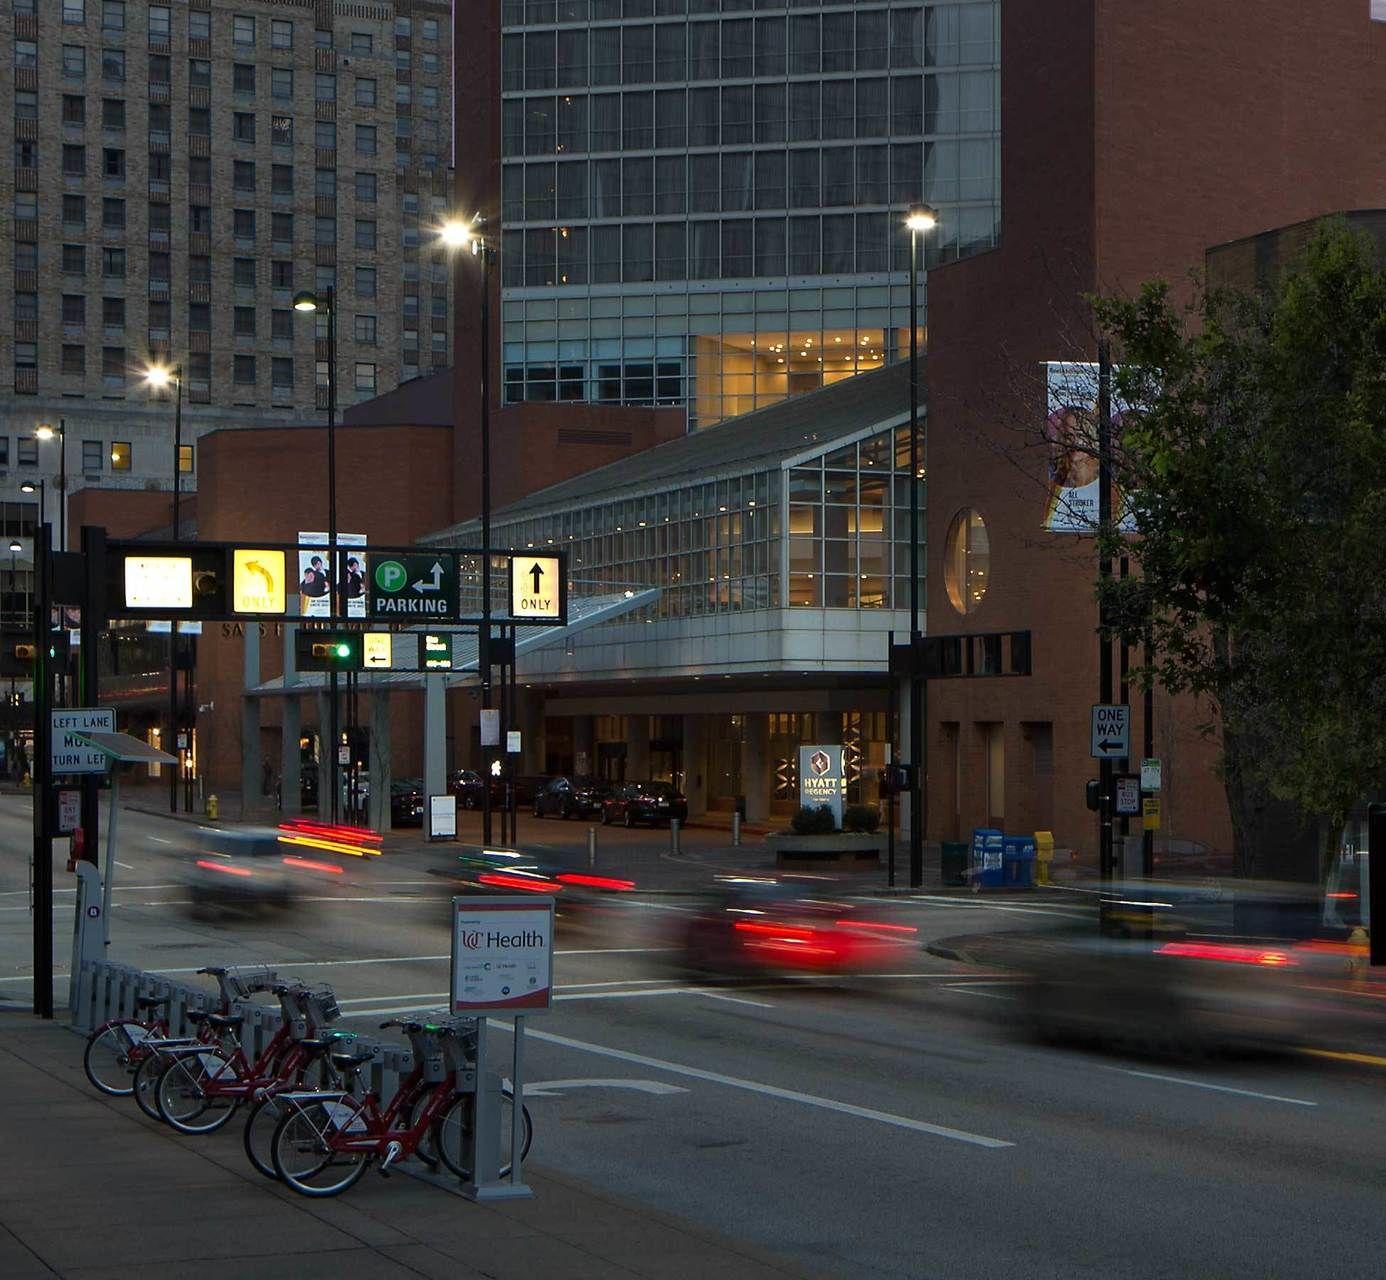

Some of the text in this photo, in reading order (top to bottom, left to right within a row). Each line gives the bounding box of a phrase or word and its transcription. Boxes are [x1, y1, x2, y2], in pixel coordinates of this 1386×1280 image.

[242, 596, 274, 608] ONLY
[376, 598, 447, 613] PARKING
[521, 598, 551, 610] ONLY
[1098, 709, 1124, 721] ONE
[53, 717, 109, 728] LEFT LANE
[1097, 724, 1124, 736] WAY
[64, 735, 91, 748] MU
[53, 754, 105, 765] TURN LEF
[804, 778, 838, 788] HYATT
[487, 930, 543, 948] Health
